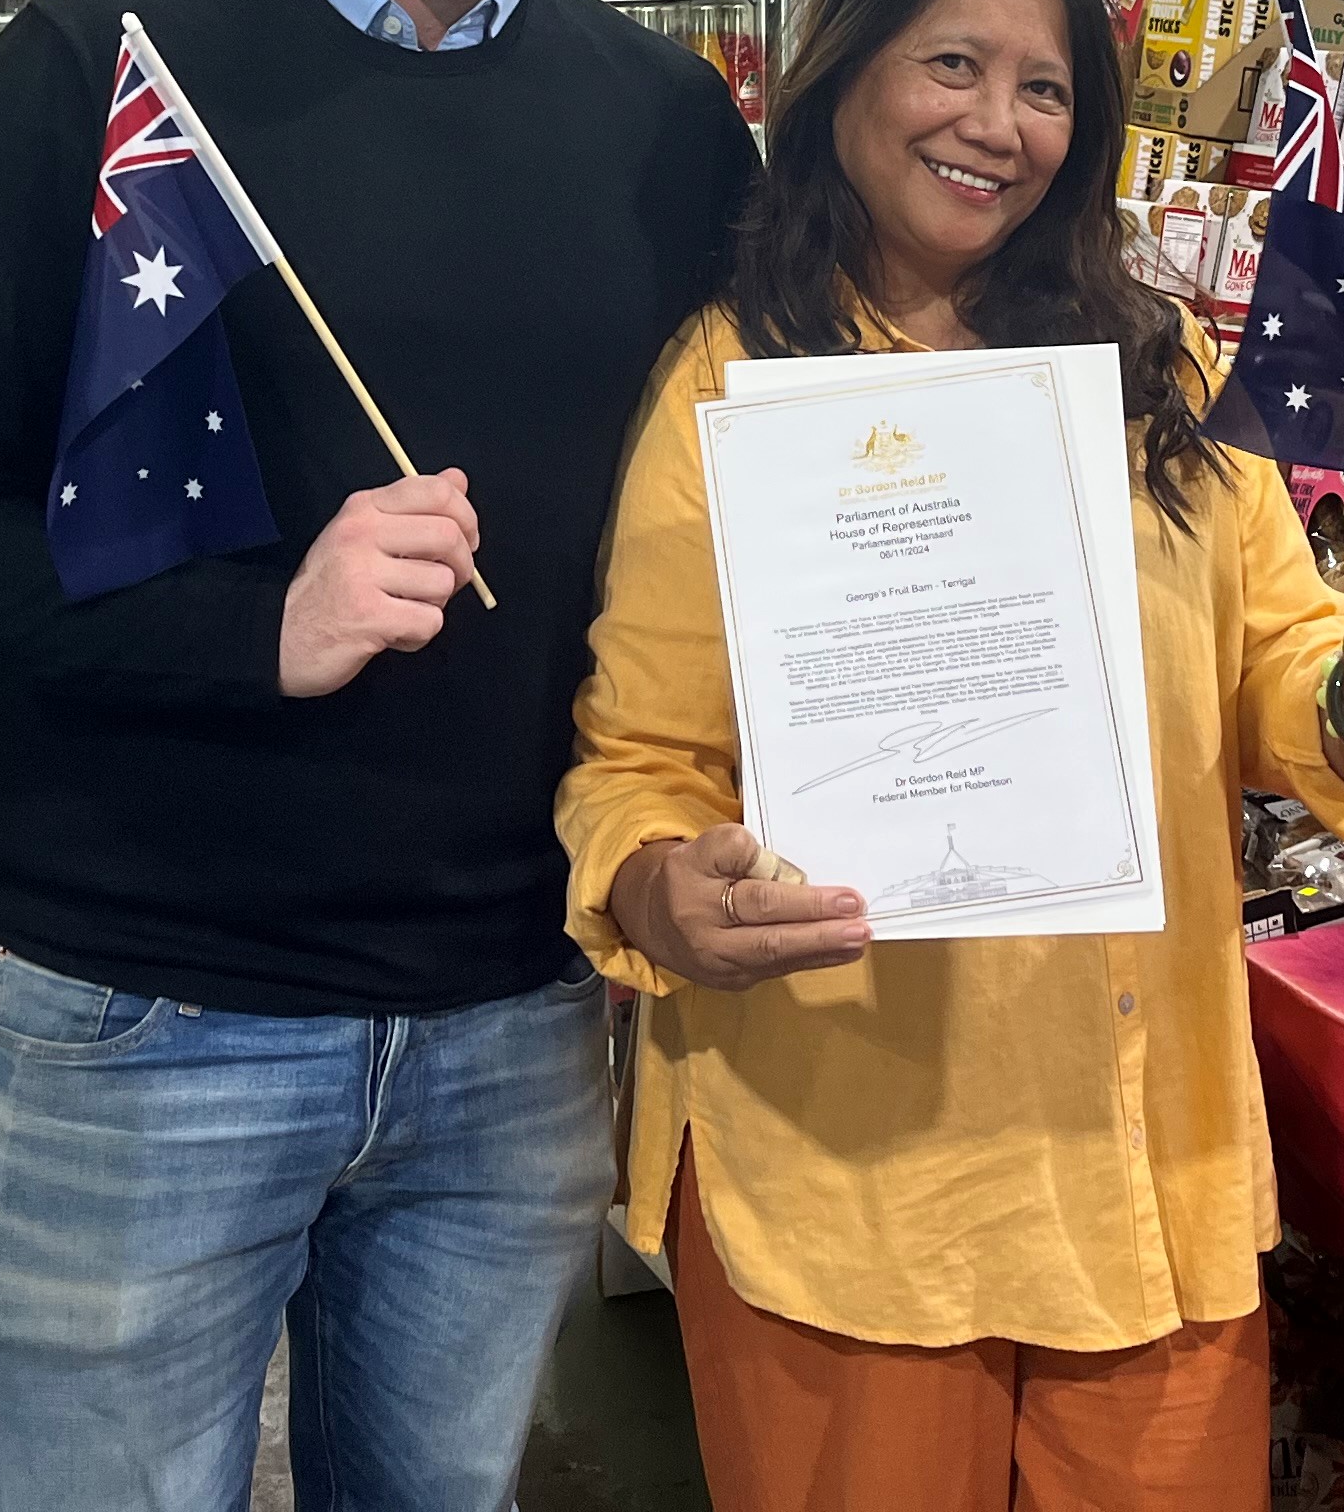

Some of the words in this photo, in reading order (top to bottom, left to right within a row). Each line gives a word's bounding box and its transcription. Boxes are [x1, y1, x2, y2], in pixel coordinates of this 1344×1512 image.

[1147, 17, 1181, 34] STICKS
[900, 475, 926, 488] Reid
[928, 472, 947, 484] MP
[836, 506, 896, 525] Parliament
[898, 504, 910, 516] of
[912, 497, 961, 514] Australia
[829, 528, 866, 541] House
[868, 523, 880, 535] of
[882, 511, 973, 534] Representatives
[852, 535, 914, 551] Parliamentary
[915, 528, 954, 542] Hansard
[845, 589, 887, 604] George's
[888, 586, 910, 597] Fruit
[911, 582, 934, 594] Barn
[941, 575, 977, 589] Terrigal
[895, 777, 907, 788] Dr
[909, 773, 944, 785] Gordon
[945, 768, 968, 780] Reid
[969, 765, 986, 776] MP
[872, 791, 908, 804] Federal
[909, 786, 948, 798] Member
[949, 783, 963, 793] for
[964, 776, 1013, 791] Robertson
